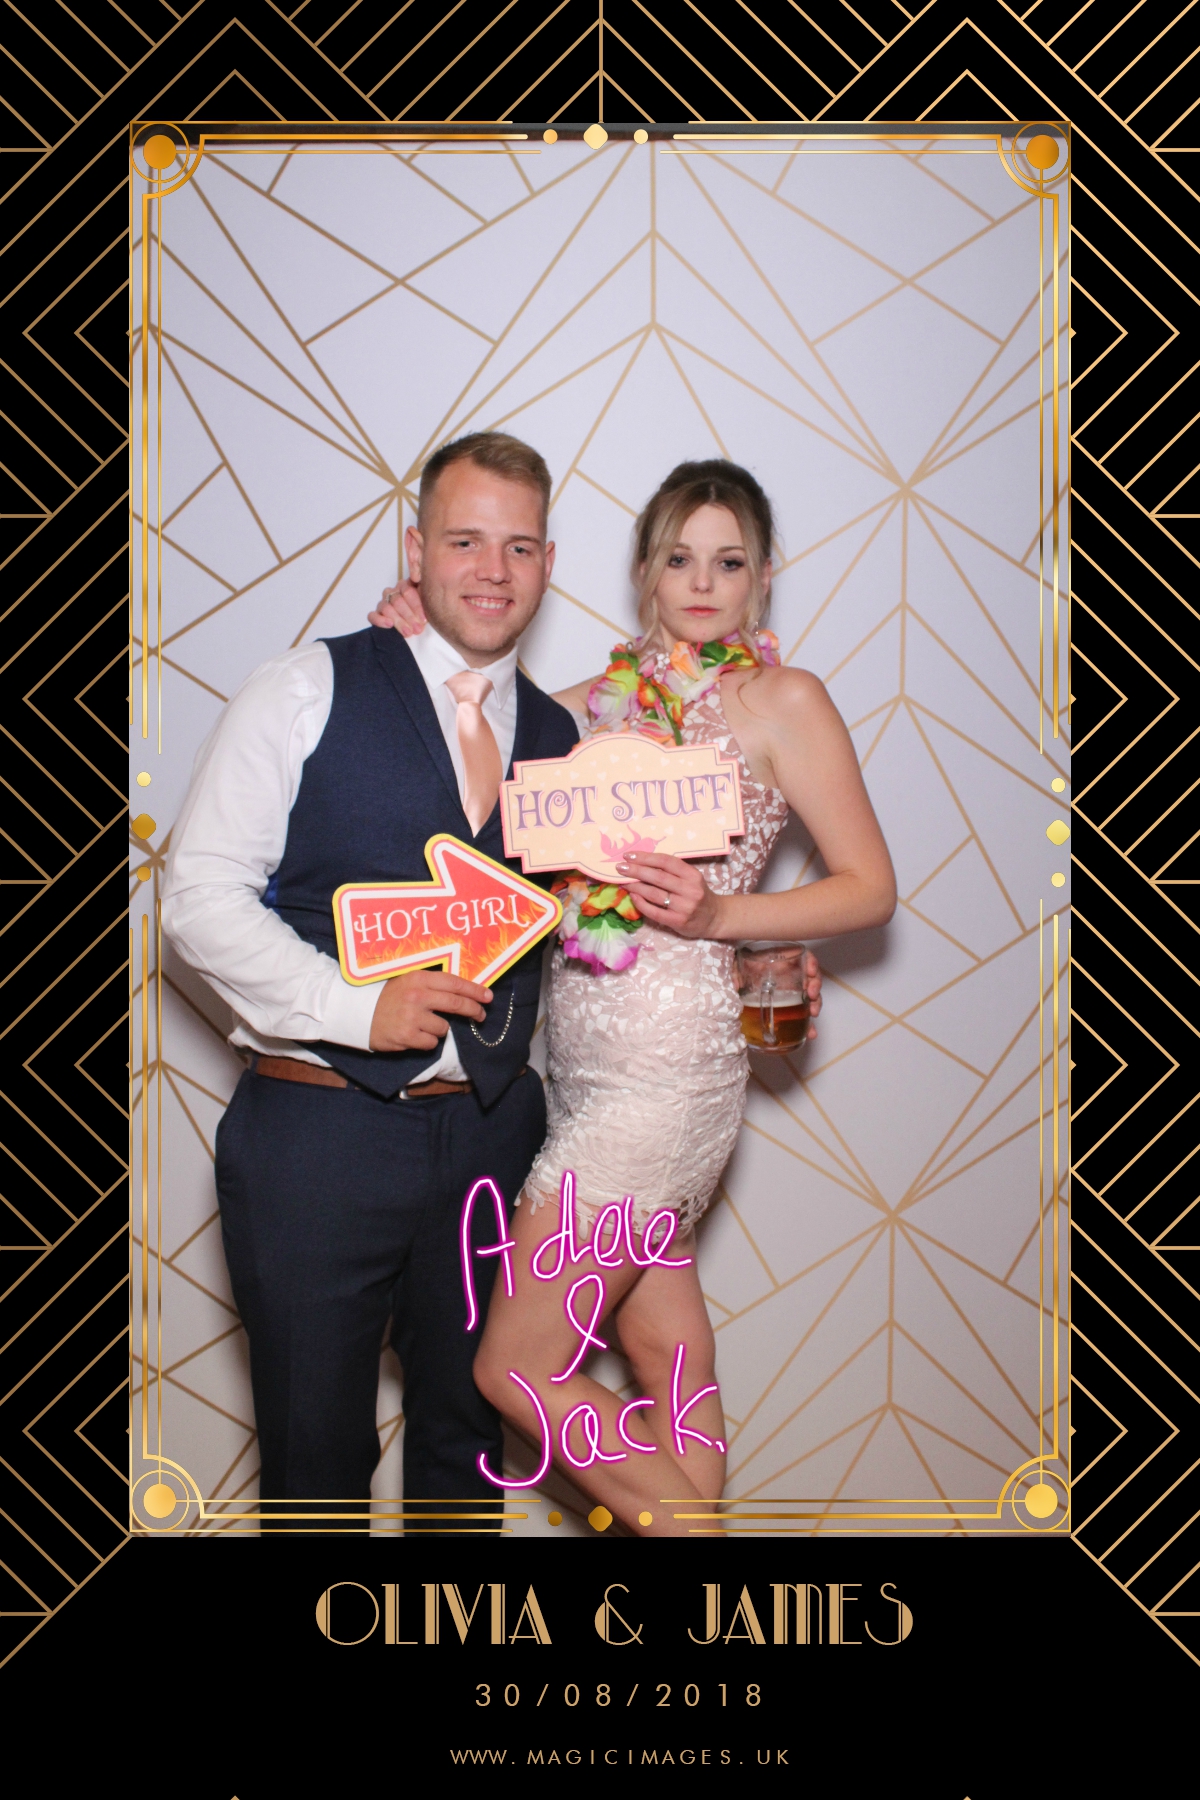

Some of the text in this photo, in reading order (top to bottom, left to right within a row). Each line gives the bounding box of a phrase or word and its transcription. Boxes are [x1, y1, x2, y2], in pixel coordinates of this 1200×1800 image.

[514, 772, 733, 831] HOT STUFF
[353, 892, 532, 945] HOT GIRL
